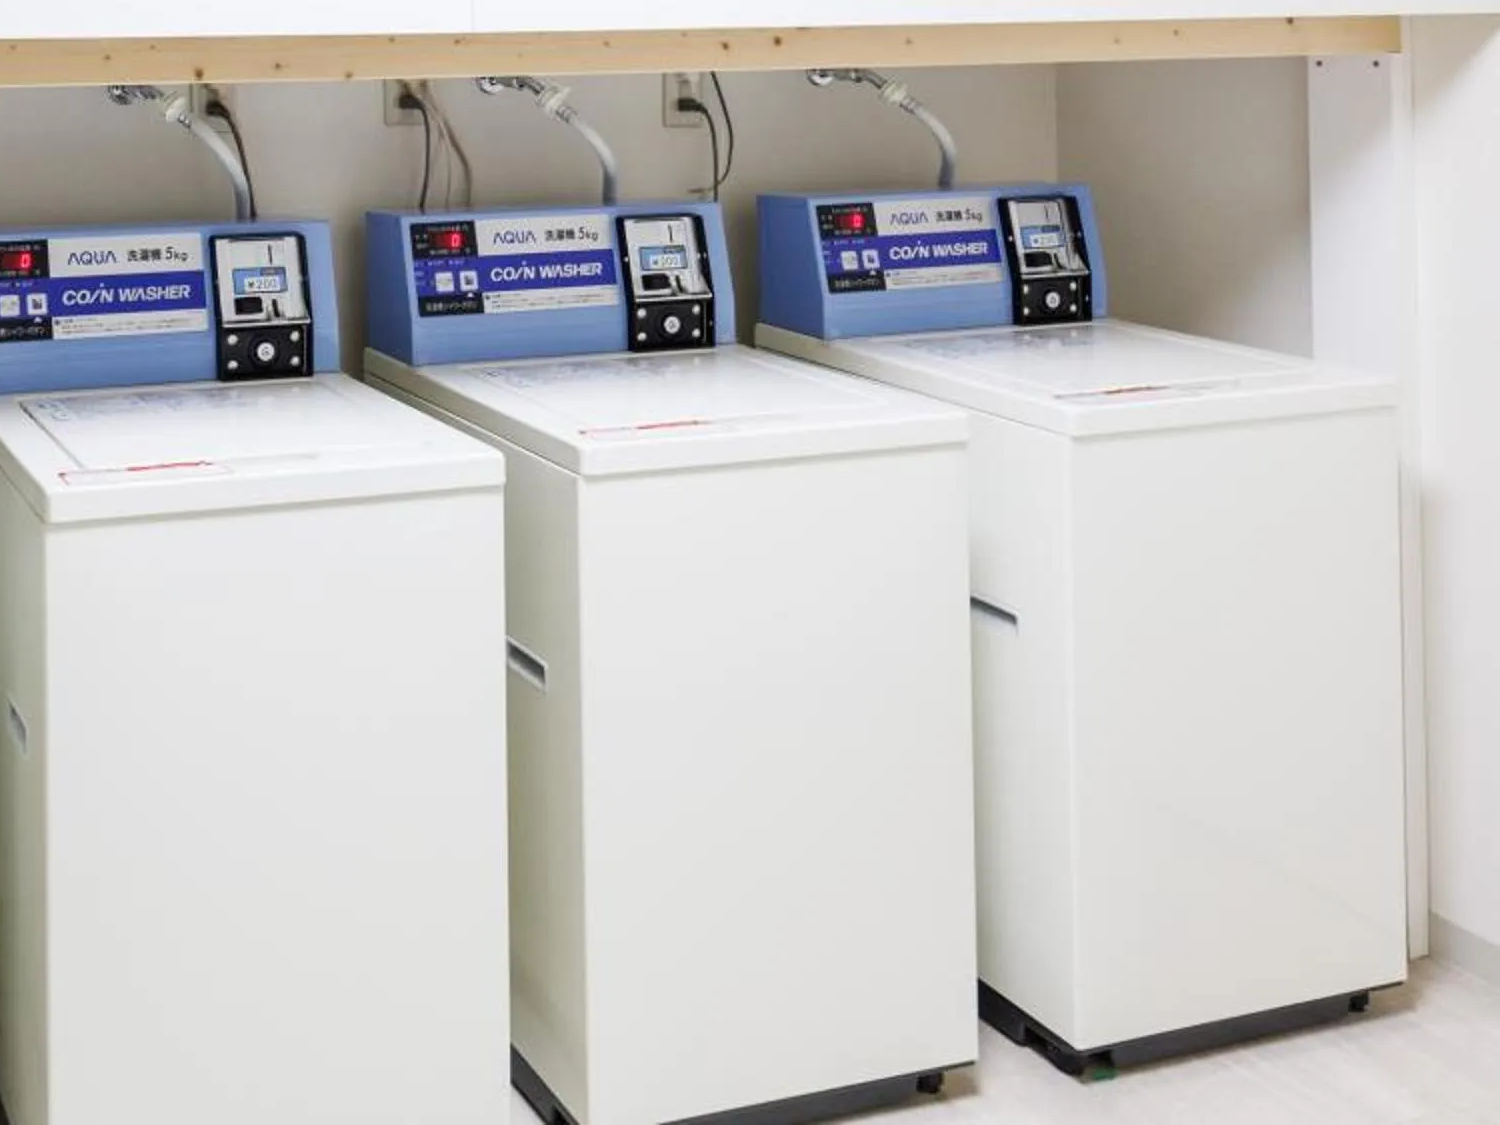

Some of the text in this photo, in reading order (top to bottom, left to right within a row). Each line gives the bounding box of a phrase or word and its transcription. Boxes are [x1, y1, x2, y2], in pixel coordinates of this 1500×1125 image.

[889, 211, 929, 225] AQUA
[450, 232, 460, 248] 0
[493, 231, 537, 245] AQUA
[577, 227, 599, 242] 5kg
[67, 246, 189, 266] AQUA 洗濯機 5kg
[933, 241, 989, 256] WASHER
[19, 252, 31, 268] 0
[539, 262, 603, 279] WASHER
[118, 284, 191, 303] WASHER
